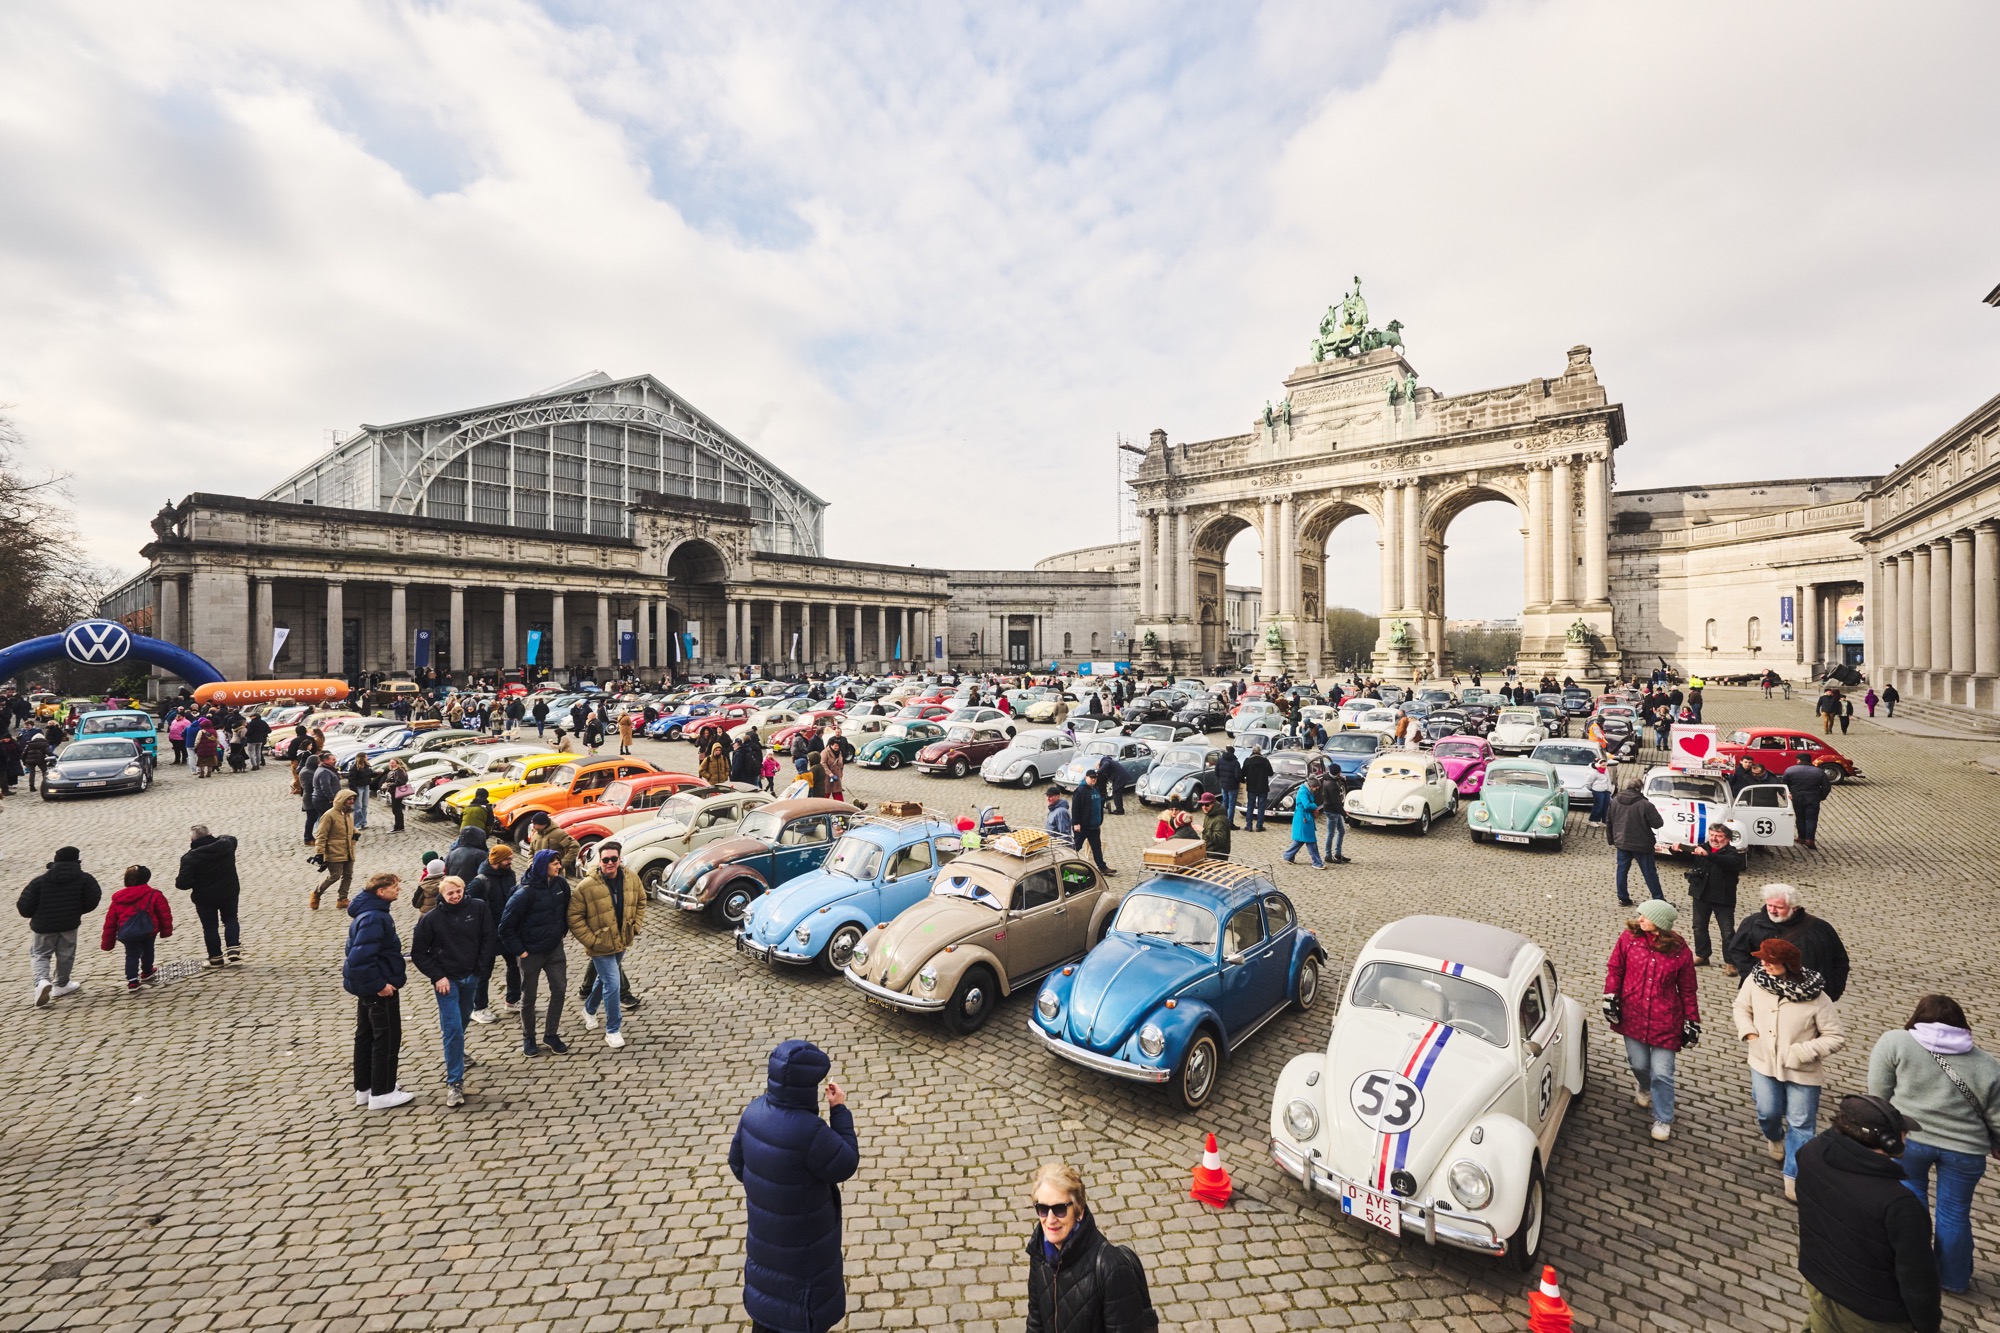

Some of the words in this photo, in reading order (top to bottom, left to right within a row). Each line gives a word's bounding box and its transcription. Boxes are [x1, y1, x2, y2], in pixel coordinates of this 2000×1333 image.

[66, 623, 130, 664] VW
[233, 688, 320, 699] VOLKSWURST
[1677, 812, 1696, 823] 53
[1756, 820, 1773, 835] 53
[1357, 1074, 1417, 1127] 53
[1541, 1070, 1552, 1117] 53
[1366, 1208, 1392, 1230] 542
